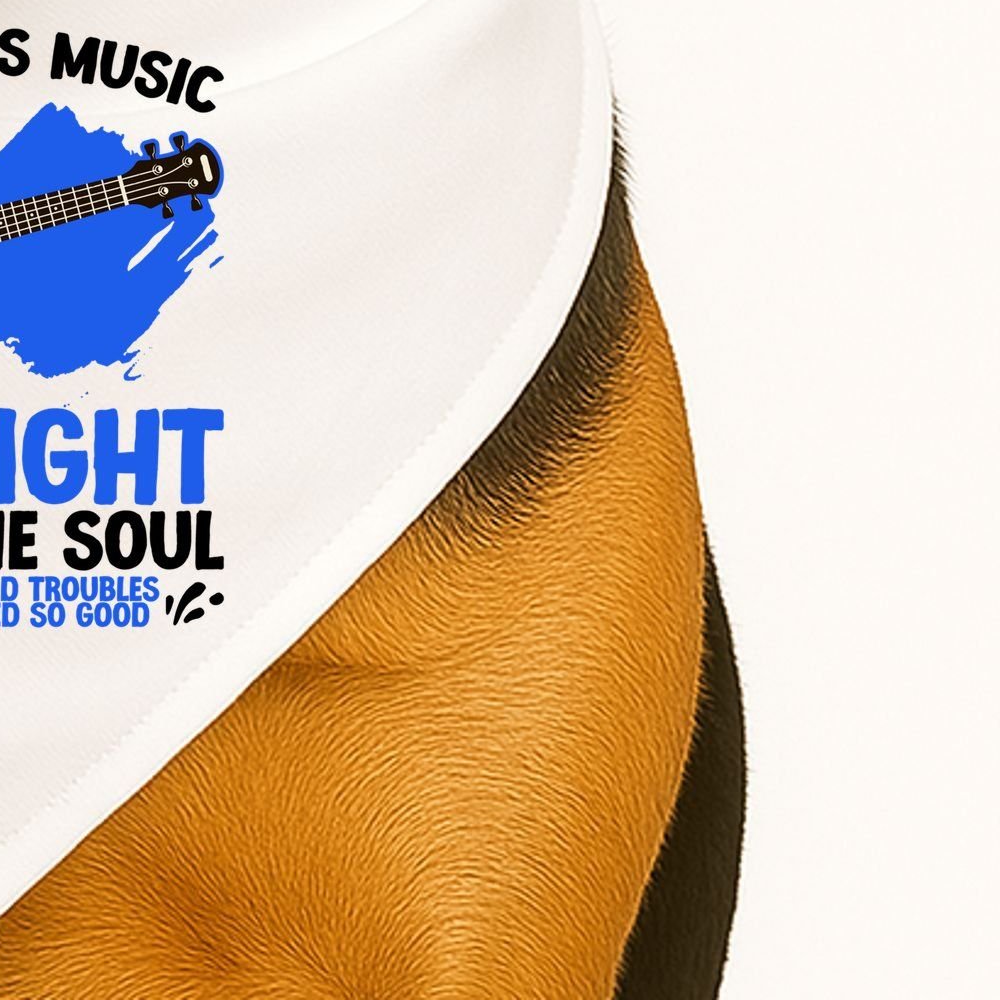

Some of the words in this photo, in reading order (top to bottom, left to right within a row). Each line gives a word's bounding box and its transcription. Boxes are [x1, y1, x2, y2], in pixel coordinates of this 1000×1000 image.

[50, 32, 225, 114] MUSIC
[63, 510, 225, 571] SOUL
[29, 576, 160, 602] TROUBLES
[30, 602, 66, 628] SO
[76, 602, 150, 628] GOOD
